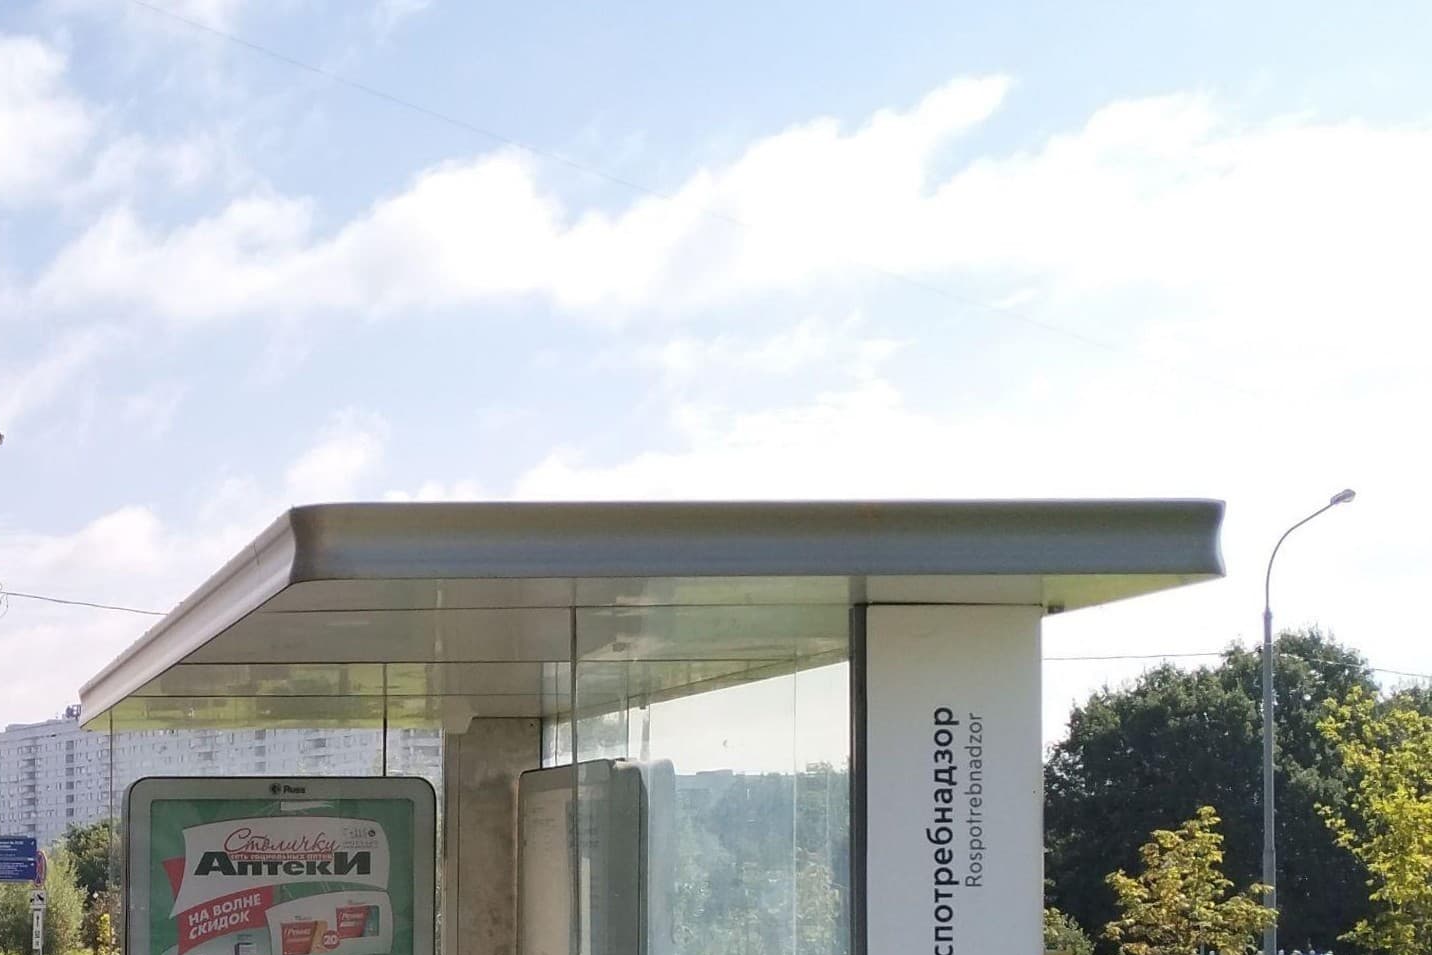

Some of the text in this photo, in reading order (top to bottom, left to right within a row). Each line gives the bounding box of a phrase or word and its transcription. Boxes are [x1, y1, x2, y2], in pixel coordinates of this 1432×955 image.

[964, 712, 986, 888] Rospotrebnadzor
[188, 893, 262, 927] НА ВОЛНЕ
[188, 910, 251, 940] СКИДОК
